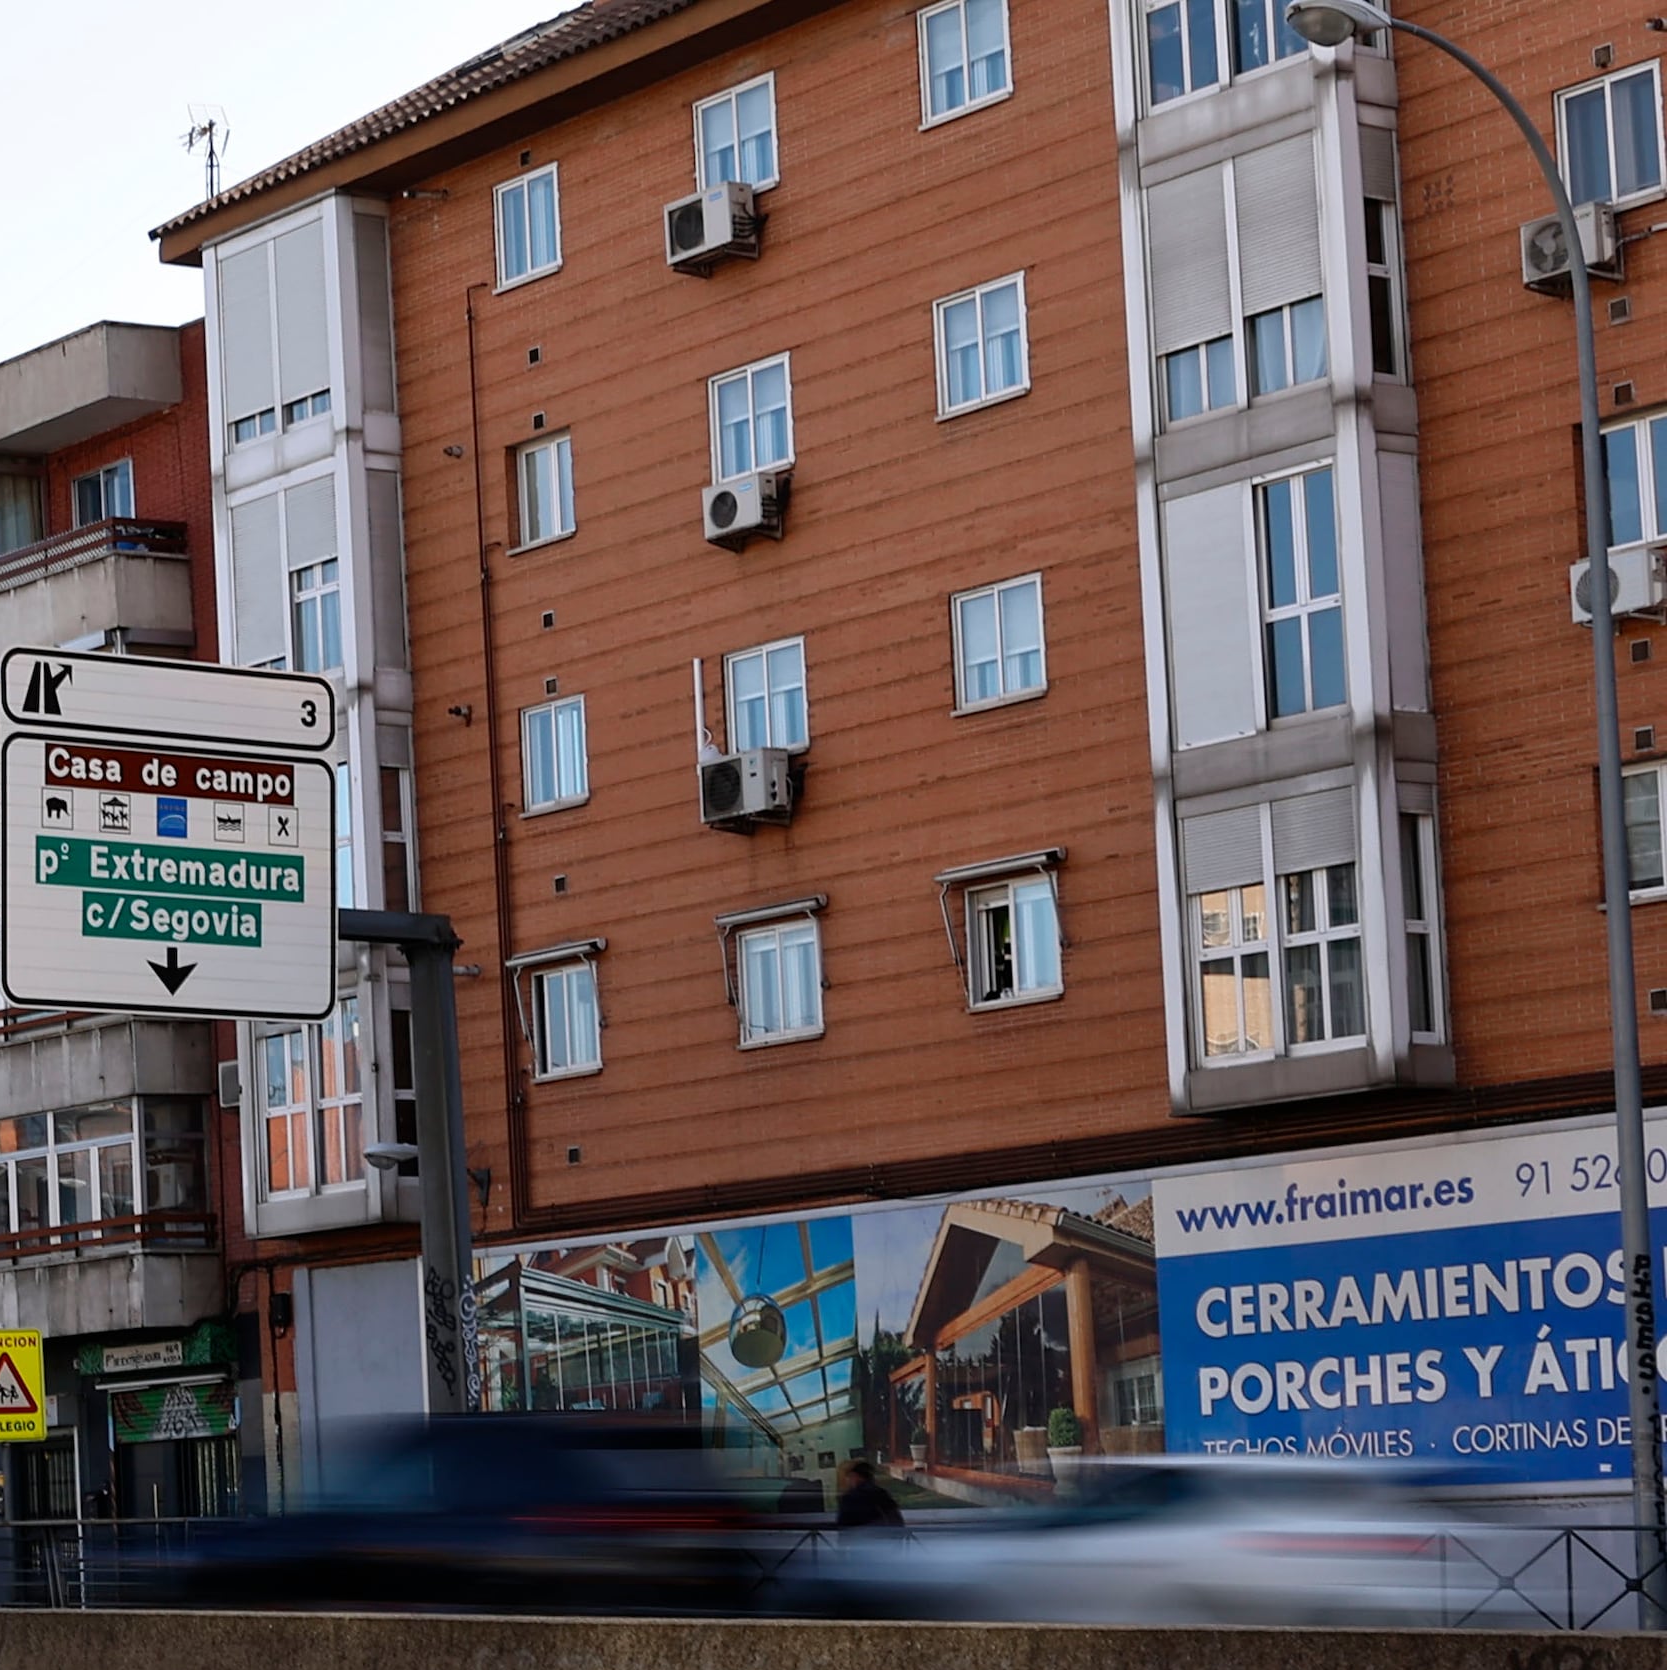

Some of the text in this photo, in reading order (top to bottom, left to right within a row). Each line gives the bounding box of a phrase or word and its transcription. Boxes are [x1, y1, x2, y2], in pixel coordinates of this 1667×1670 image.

[300, 701, 317, 728] 3
[48, 747, 292, 802] Casa de campo
[90, 845, 300, 893] Extremadura
[1176, 1176, 1474, 1233] www.fraimar.es
[1516, 1161, 1550, 1197] 91
[1199, 1349, 1446, 1416] PORCHES
[1463, 1345, 1504, 1397] Y
[1306, 1426, 1413, 1459] MÓVILES
[1453, 1419, 1588, 1453] CORTINAS
